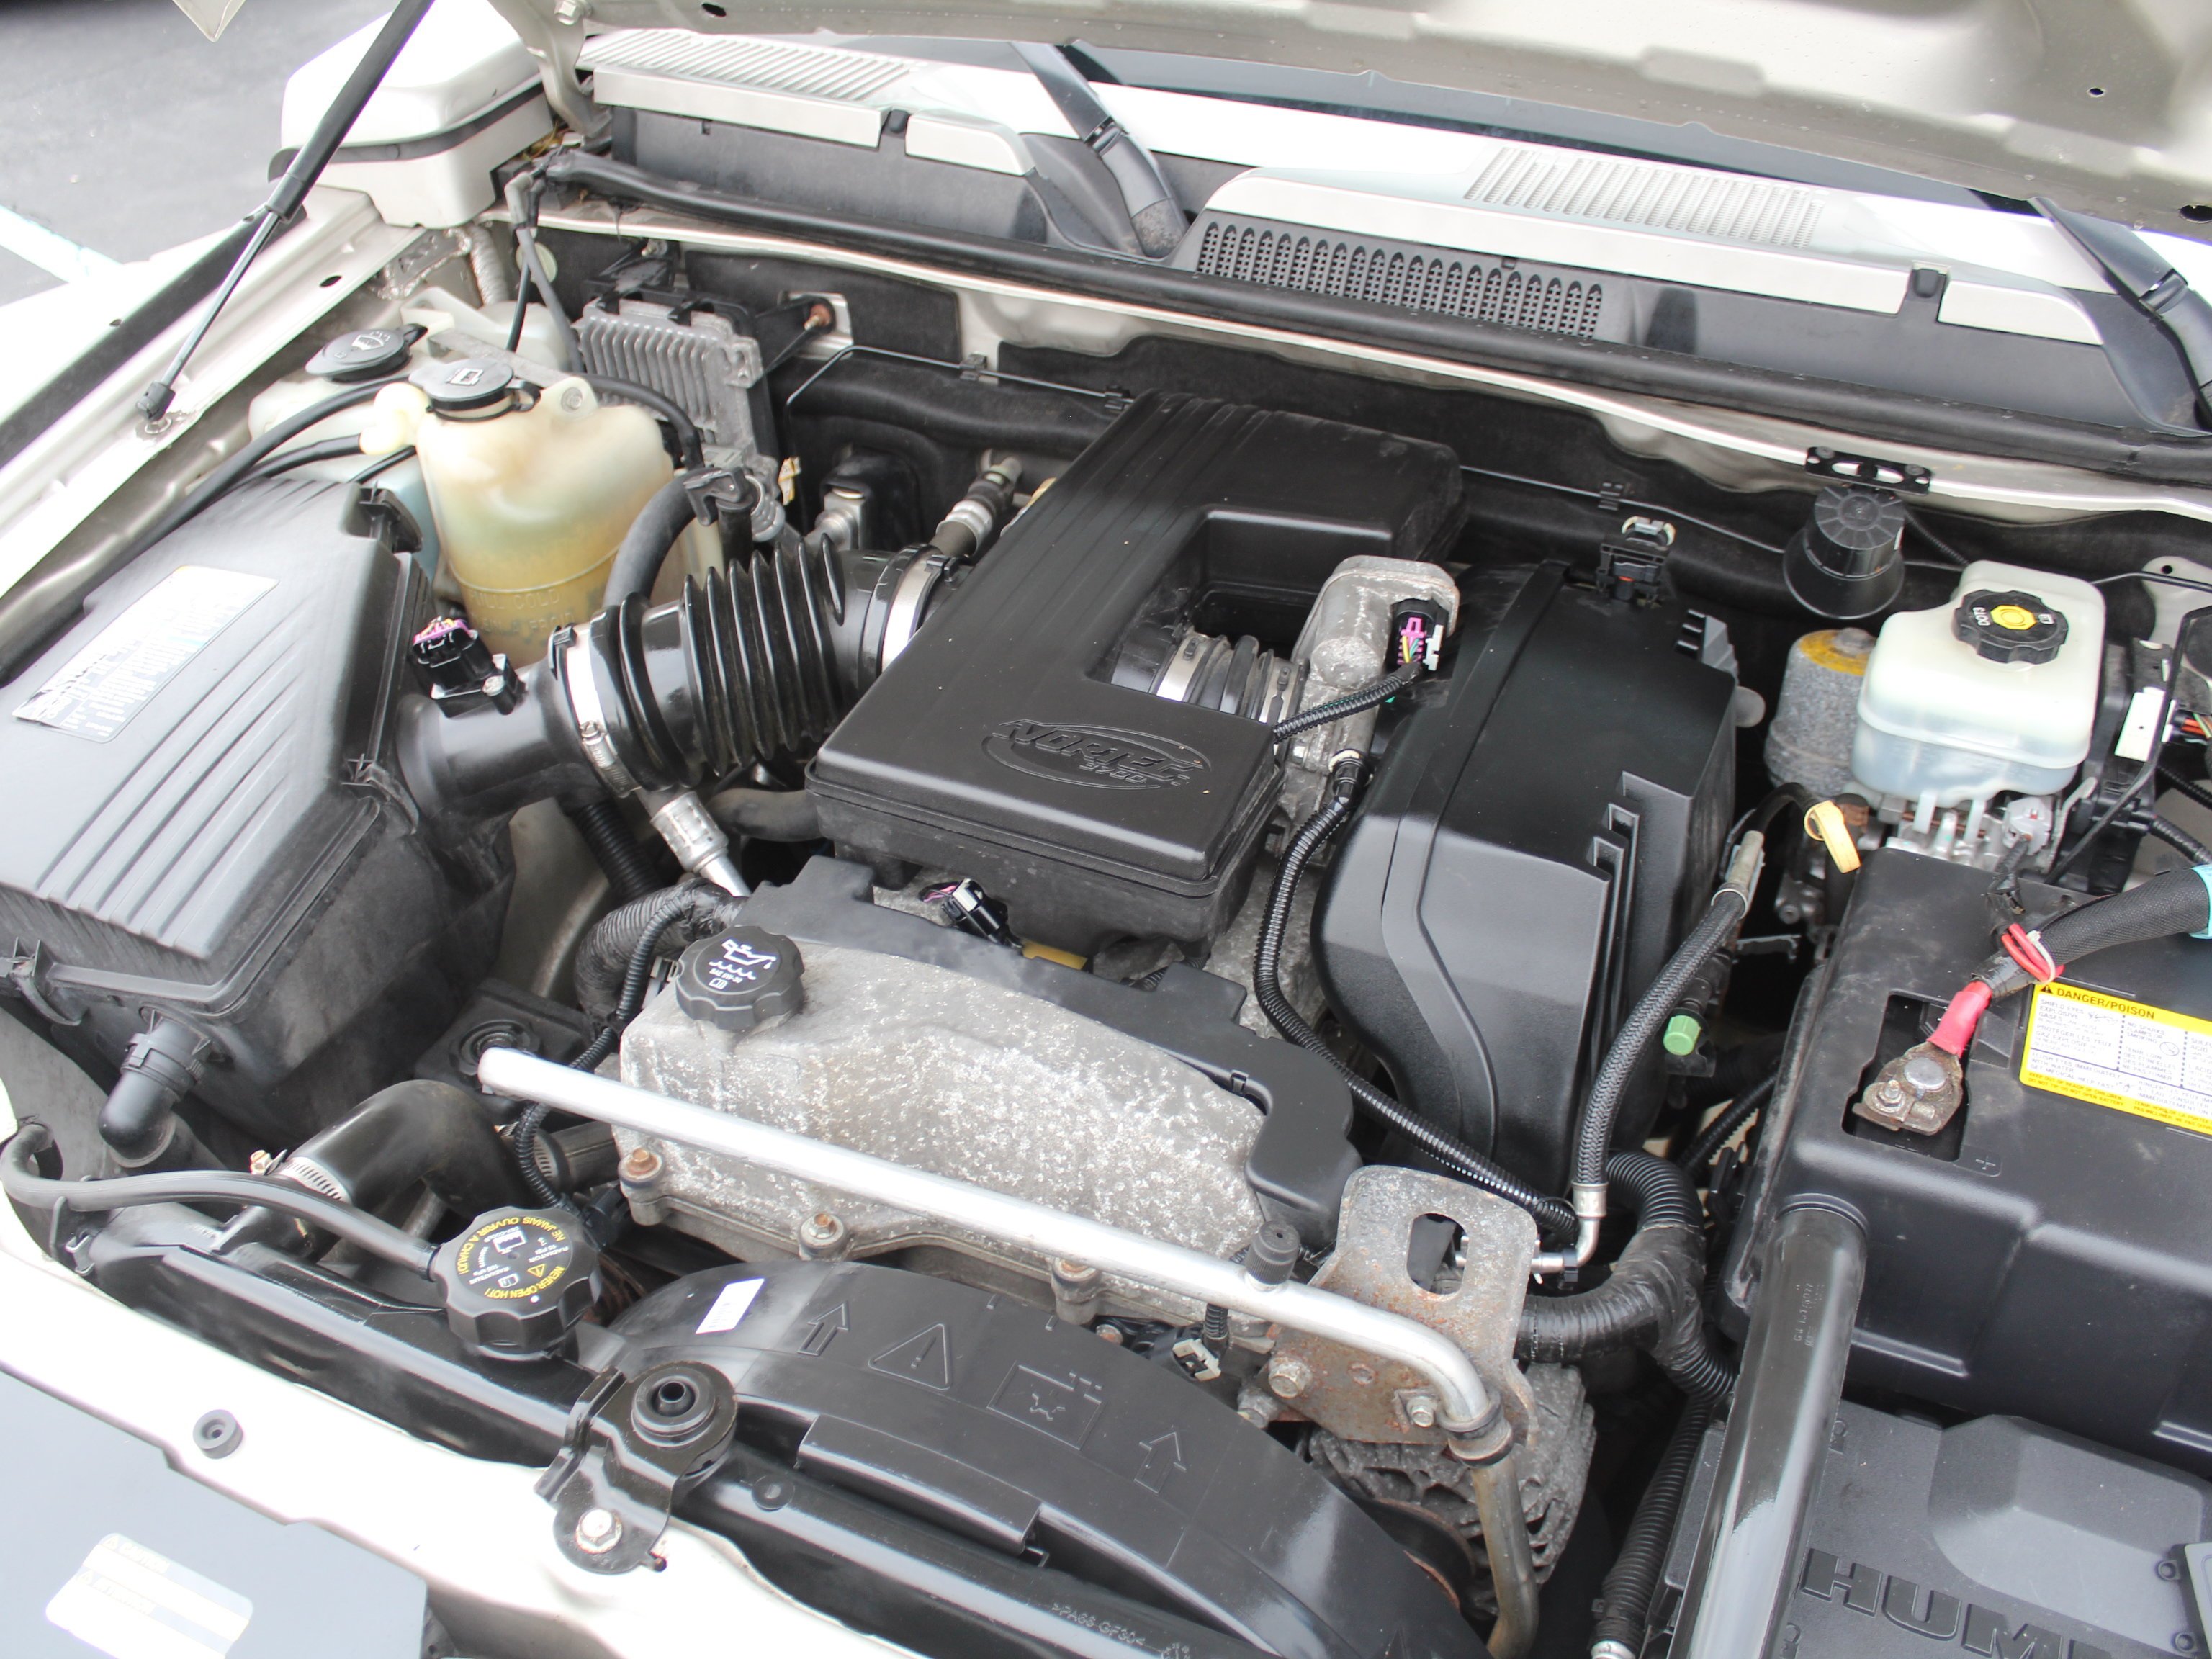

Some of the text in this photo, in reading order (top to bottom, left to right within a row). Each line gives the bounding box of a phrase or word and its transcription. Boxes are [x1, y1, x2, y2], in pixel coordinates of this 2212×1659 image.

[513, 588, 560, 610] COLD
[1972, 607, 1991, 626] DOT3
[1010, 721, 1193, 782] VORTEC
[1079, 761, 1148, 785] 3700
[2040, 1005, 2078, 1018] EXPLOSIVE
[2041, 999, 2064, 1008] SHIELD
[2056, 988, 2154, 1018] DANGER/POISON
[2038, 1011, 2062, 1021] GASES
[2126, 1032, 2157, 1043] SMOKING
[2127, 1027, 2151, 1035] FLAMES
[2140, 1025, 2164, 1034] SPARKS
[2045, 1068, 2074, 1078] MEDICAL
[477, 1217, 519, 1236] OUVRIR
[523, 1217, 557, 1233] JAMAIS
[551, 1231, 567, 1243] NE
[457, 1243, 474, 1274] CHAUD!
[528, 1246, 569, 1263] RADIATOR
[469, 1265, 511, 1285] RADIATEUR
[484, 1265, 565, 1299] NEVER OPEN HOT!
[1800, 1547, 2117, 1659] HUM
